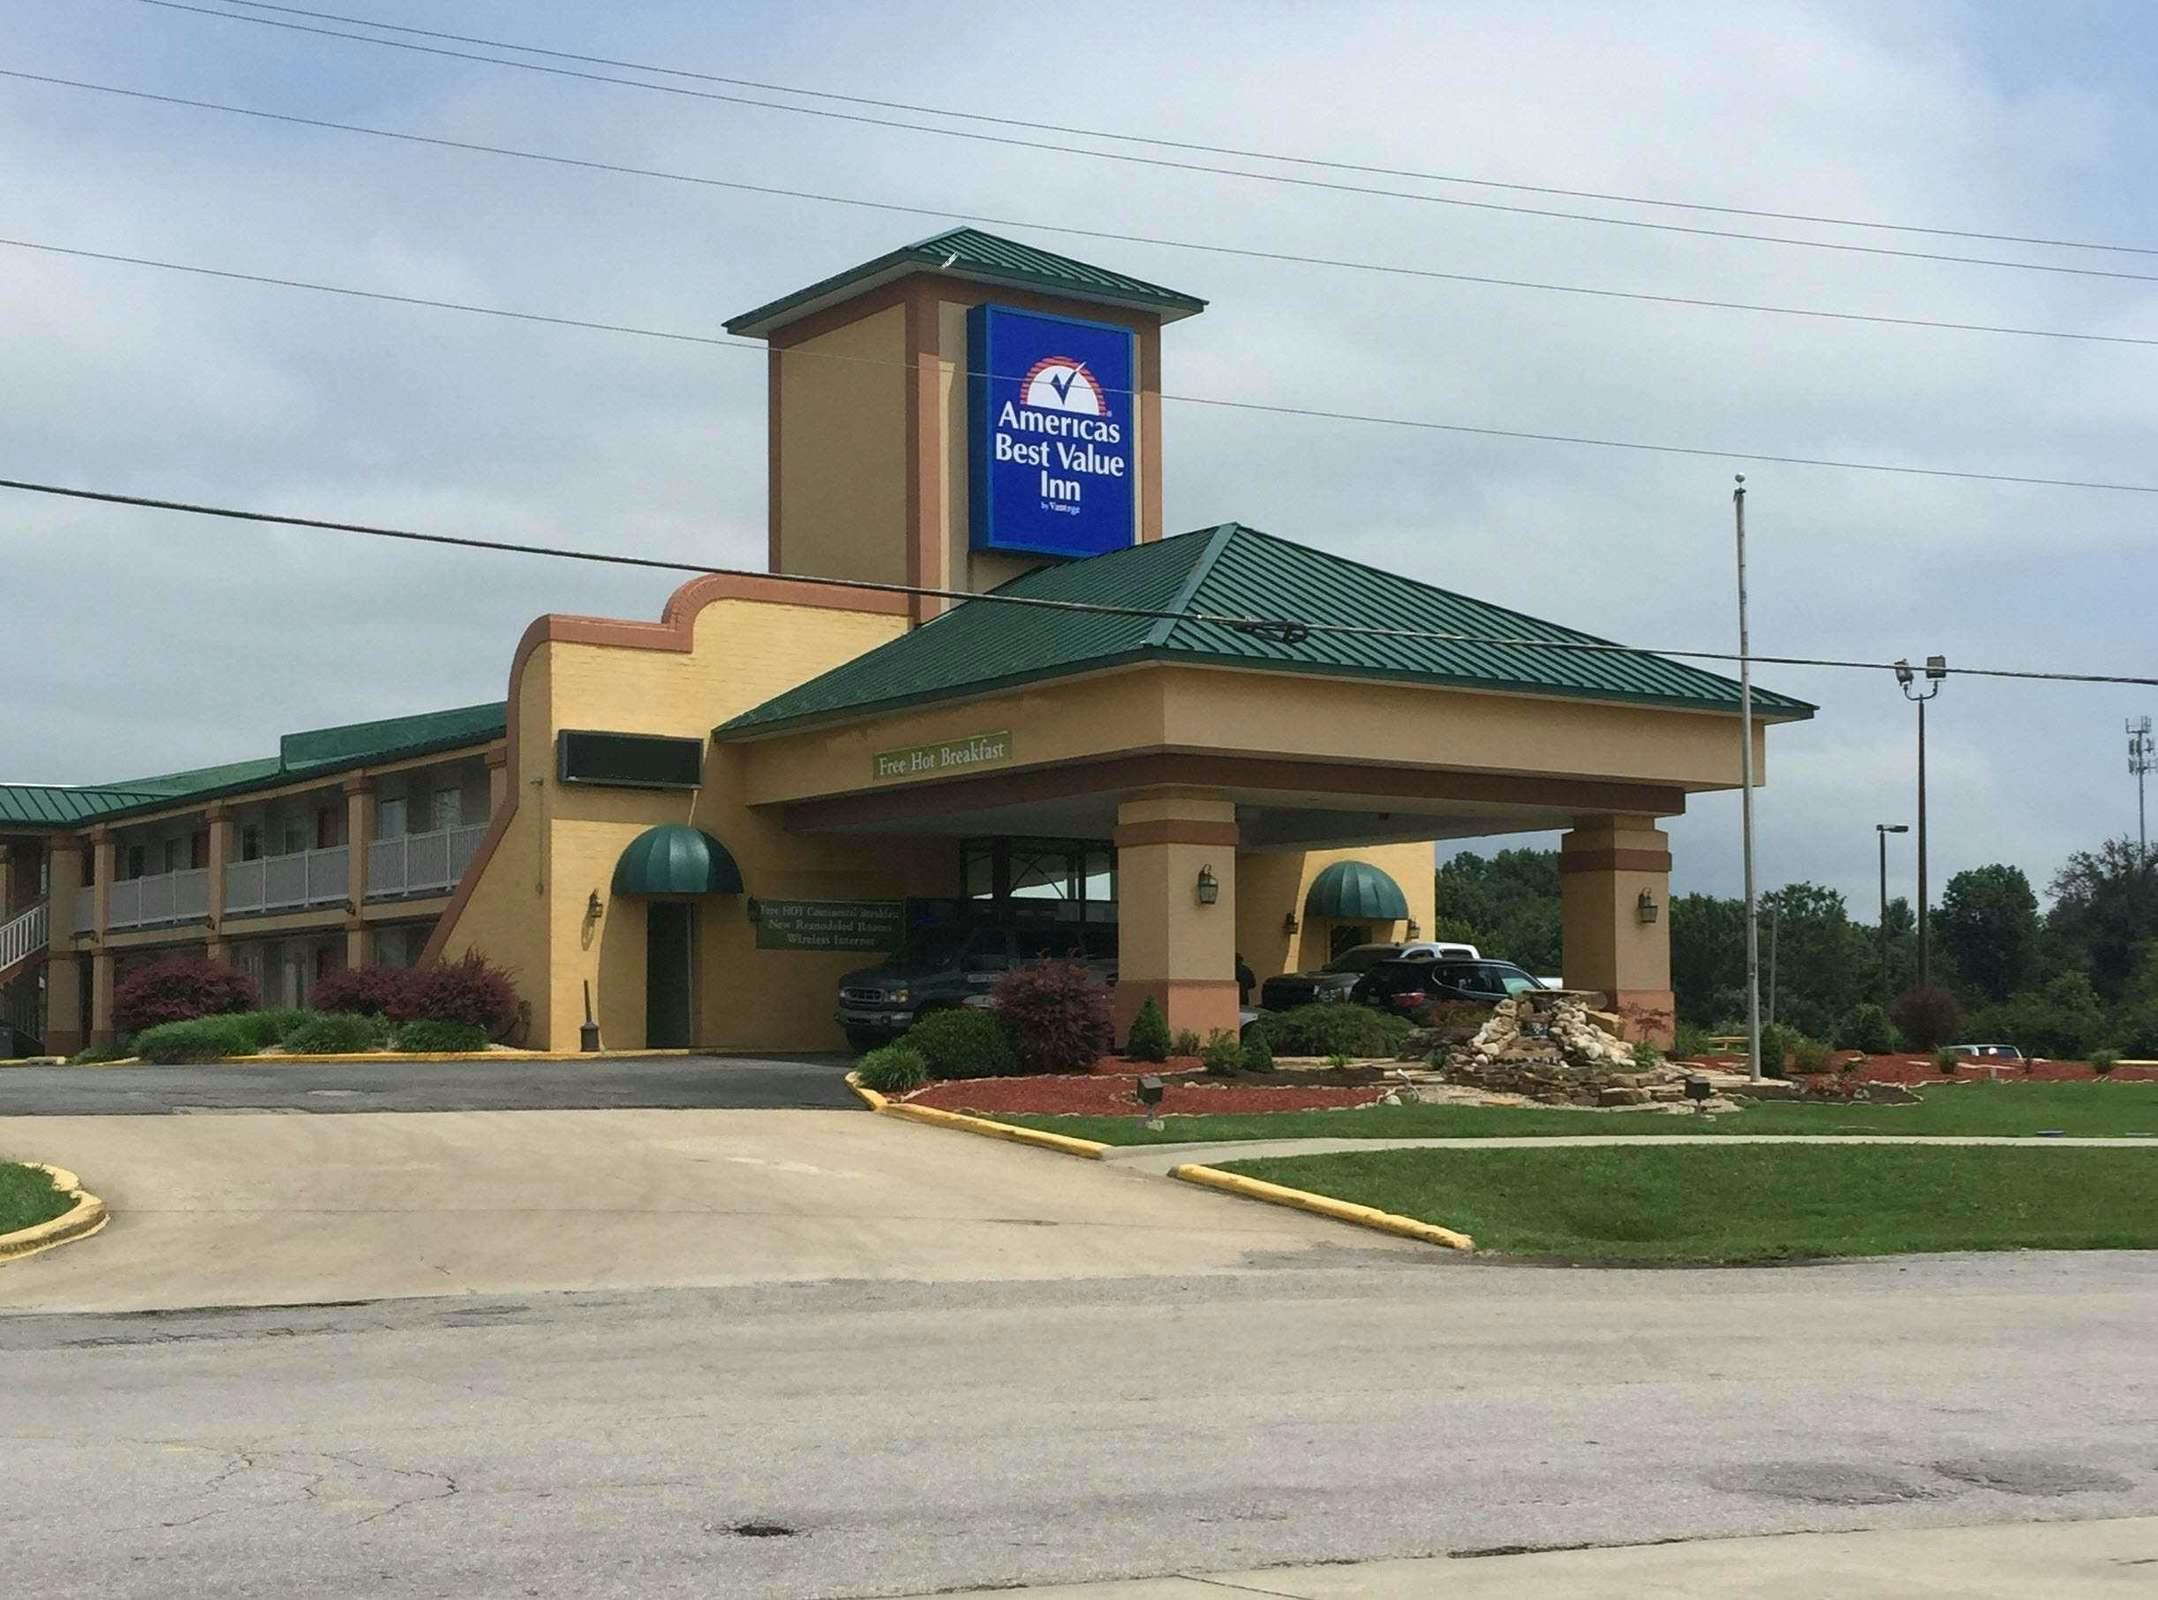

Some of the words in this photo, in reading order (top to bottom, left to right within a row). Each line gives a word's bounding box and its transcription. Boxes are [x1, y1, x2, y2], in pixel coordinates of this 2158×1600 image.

[998, 400, 1120, 443] Americas
[995, 433, 1050, 468] Best
[1056, 442, 1124, 477] Value
[1041, 470, 1081, 501] Inn
[879, 756, 906, 776] Free
[911, 751, 934, 771] Hot
[941, 739, 1005, 766] Breakfast
[787, 933, 831, 944] Wireless
